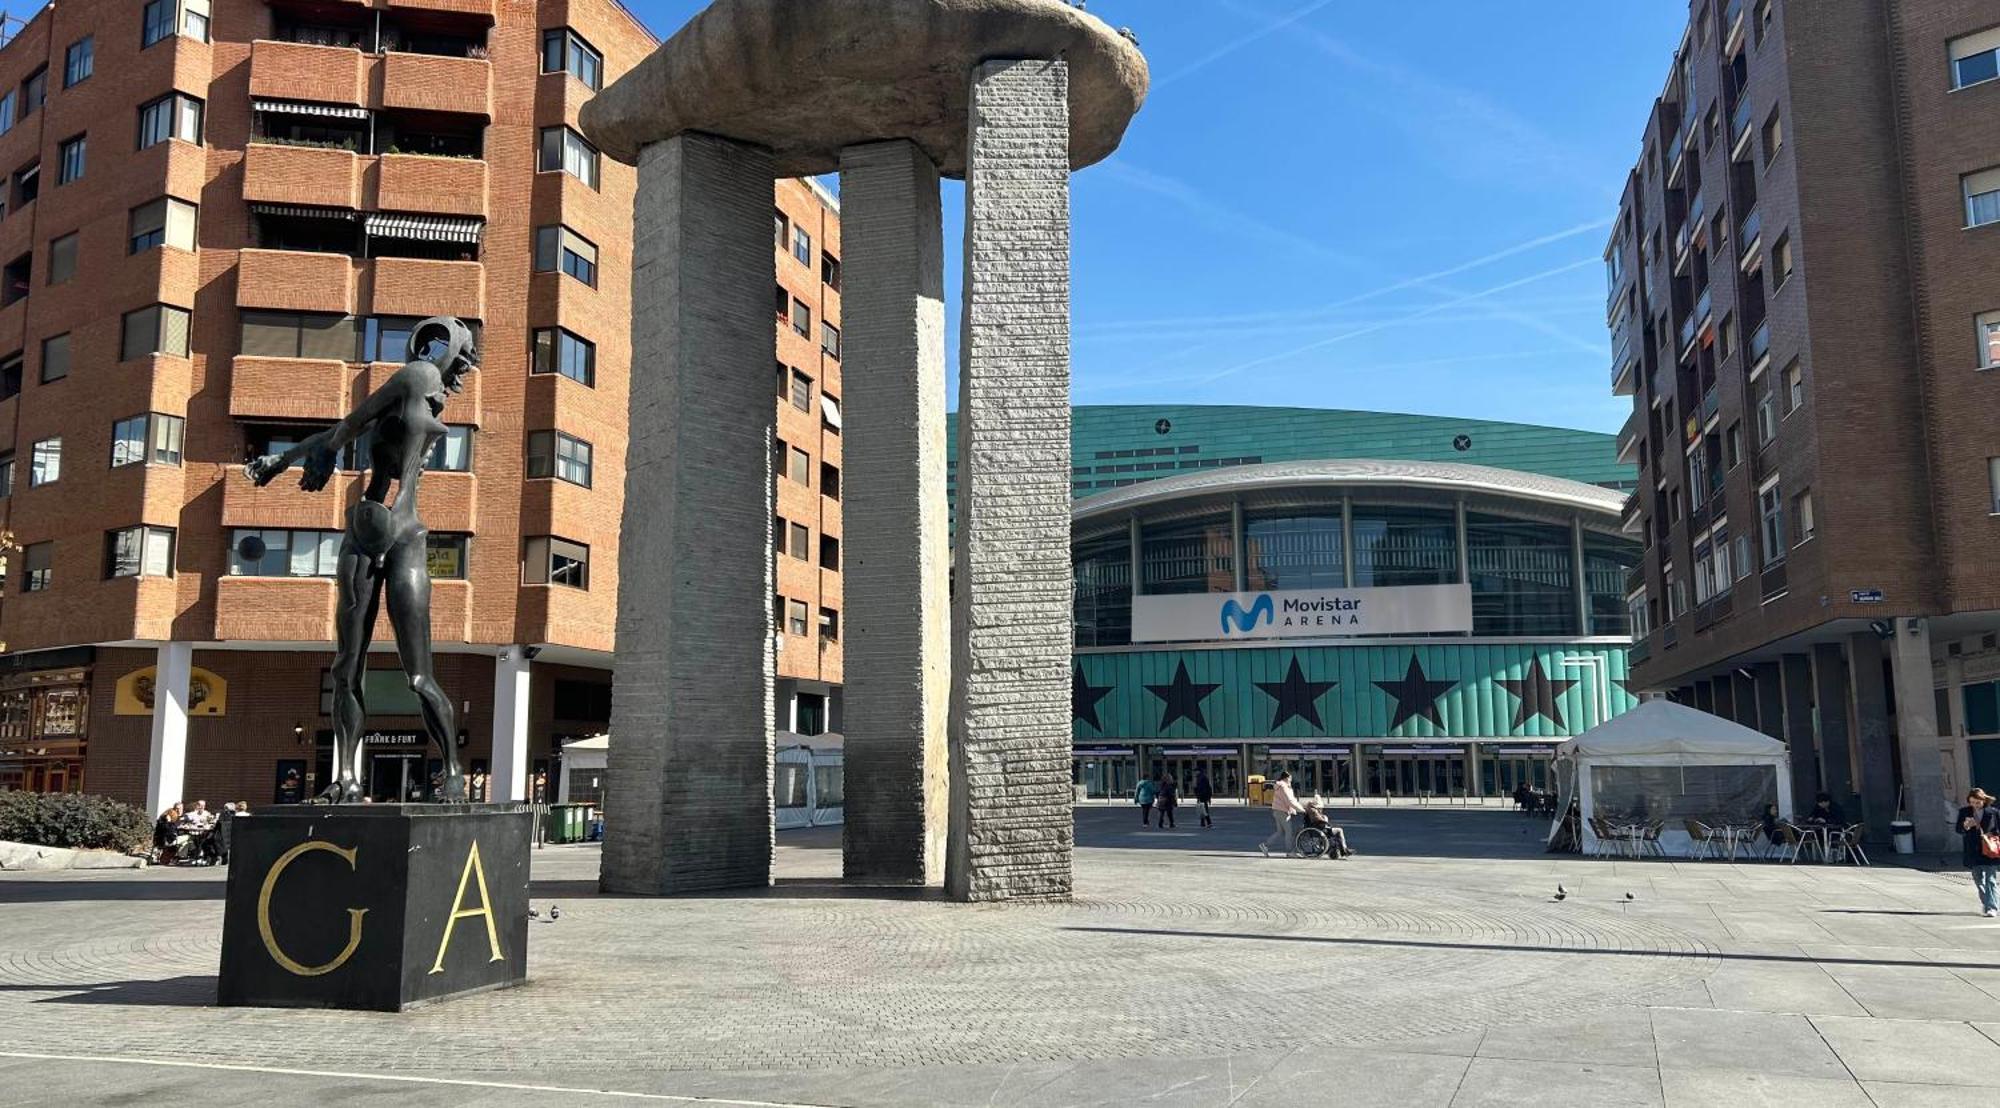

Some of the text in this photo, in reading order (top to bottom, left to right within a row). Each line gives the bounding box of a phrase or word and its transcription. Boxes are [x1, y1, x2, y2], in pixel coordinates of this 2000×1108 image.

[1283, 597, 1361, 612] Movistar
[1284, 614, 1359, 626] ARENA
[391, 735, 397, 744] &
[257, 840, 370, 977] G
[427, 839, 505, 976] A
